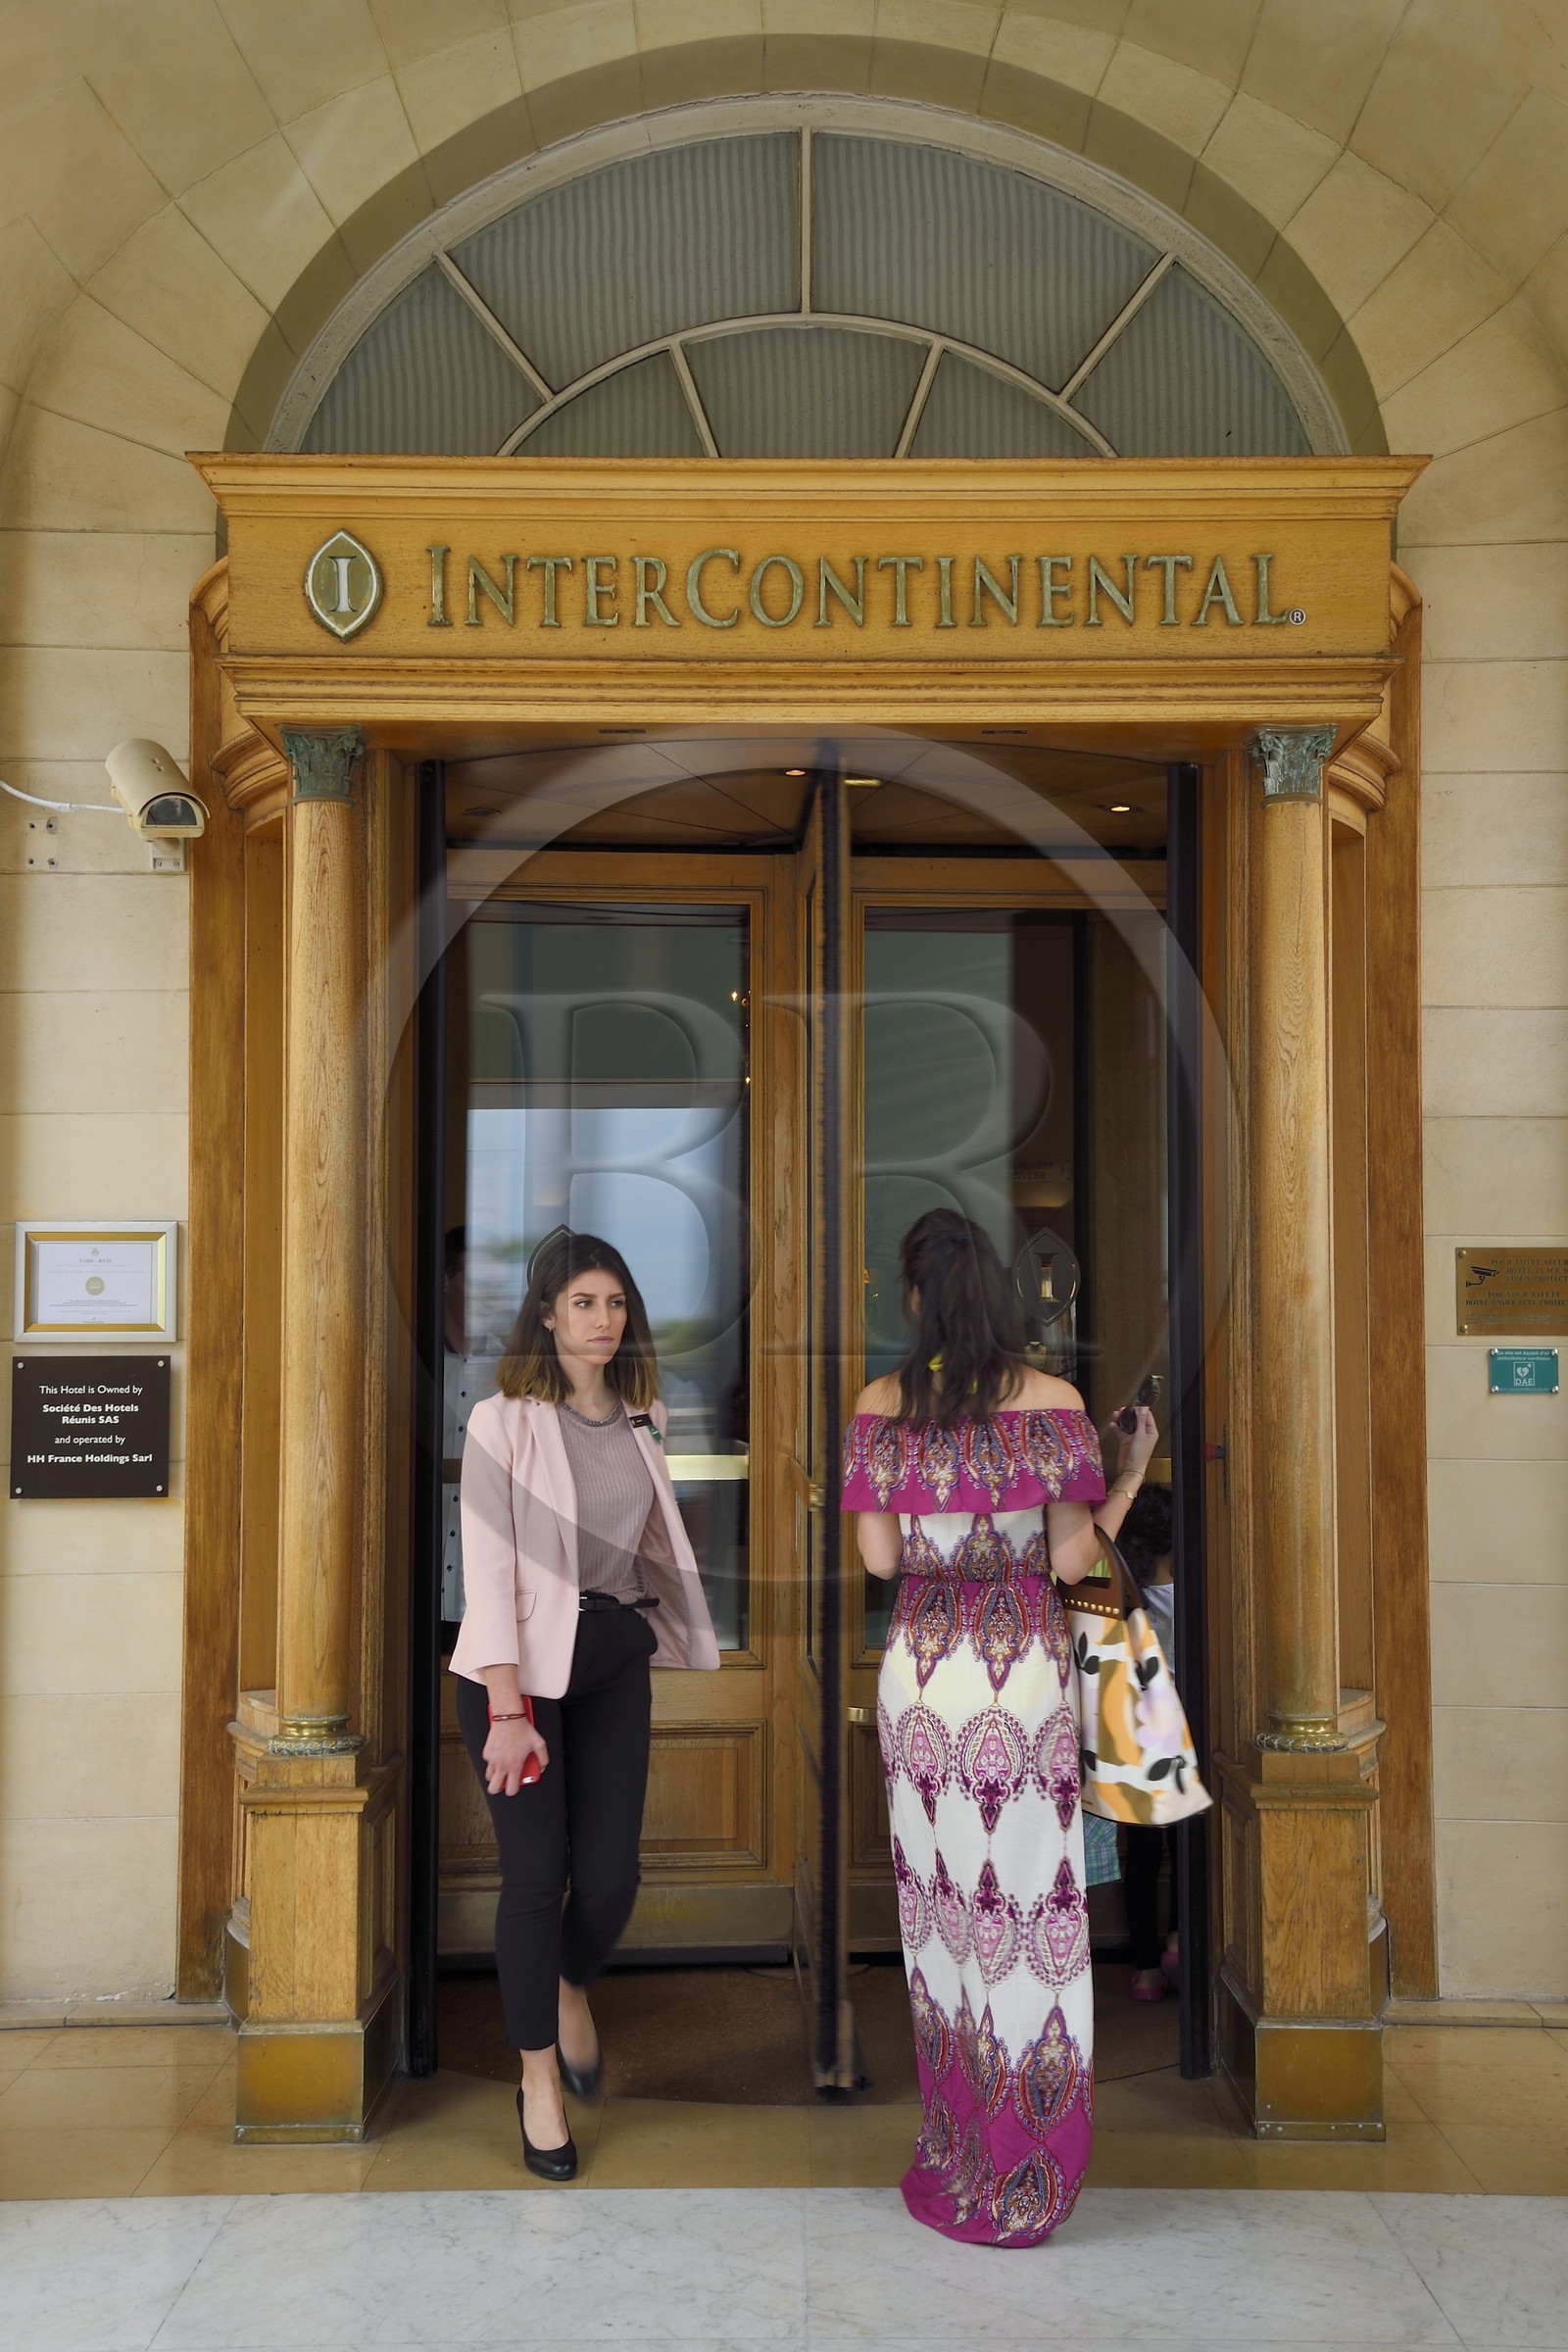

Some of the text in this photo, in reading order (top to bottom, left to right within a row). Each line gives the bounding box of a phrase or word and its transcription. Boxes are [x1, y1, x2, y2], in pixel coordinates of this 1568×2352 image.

[39, 1385, 143, 1396] This Hotel is Owned by
[42, 1403, 139, 1412] Société Des Hotels
[62, 1415, 120, 1424] Réunis SAS
[54, 1435, 125, 1446] and operated by
[26, 1453, 153, 1464] HH France Holdings Sarl
